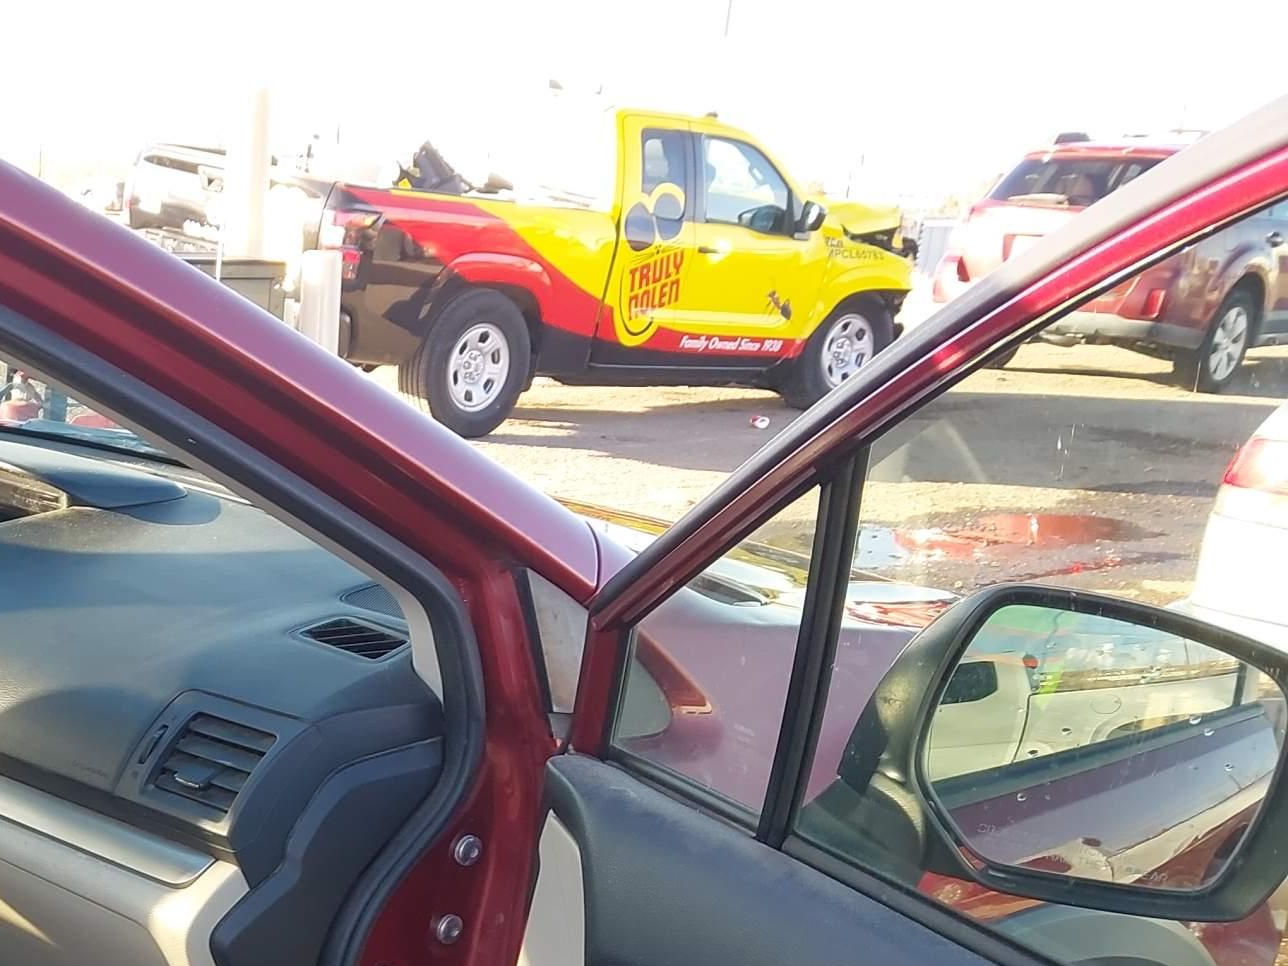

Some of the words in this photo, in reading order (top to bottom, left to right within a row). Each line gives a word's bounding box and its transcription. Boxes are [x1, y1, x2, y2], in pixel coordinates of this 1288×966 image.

[629, 250, 684, 293] TRULY
[628, 279, 681, 322] NOLEN
[679, 335, 708, 352] Family
[708, 336, 741, 350] Owned
[738, 338, 761, 351] Since
